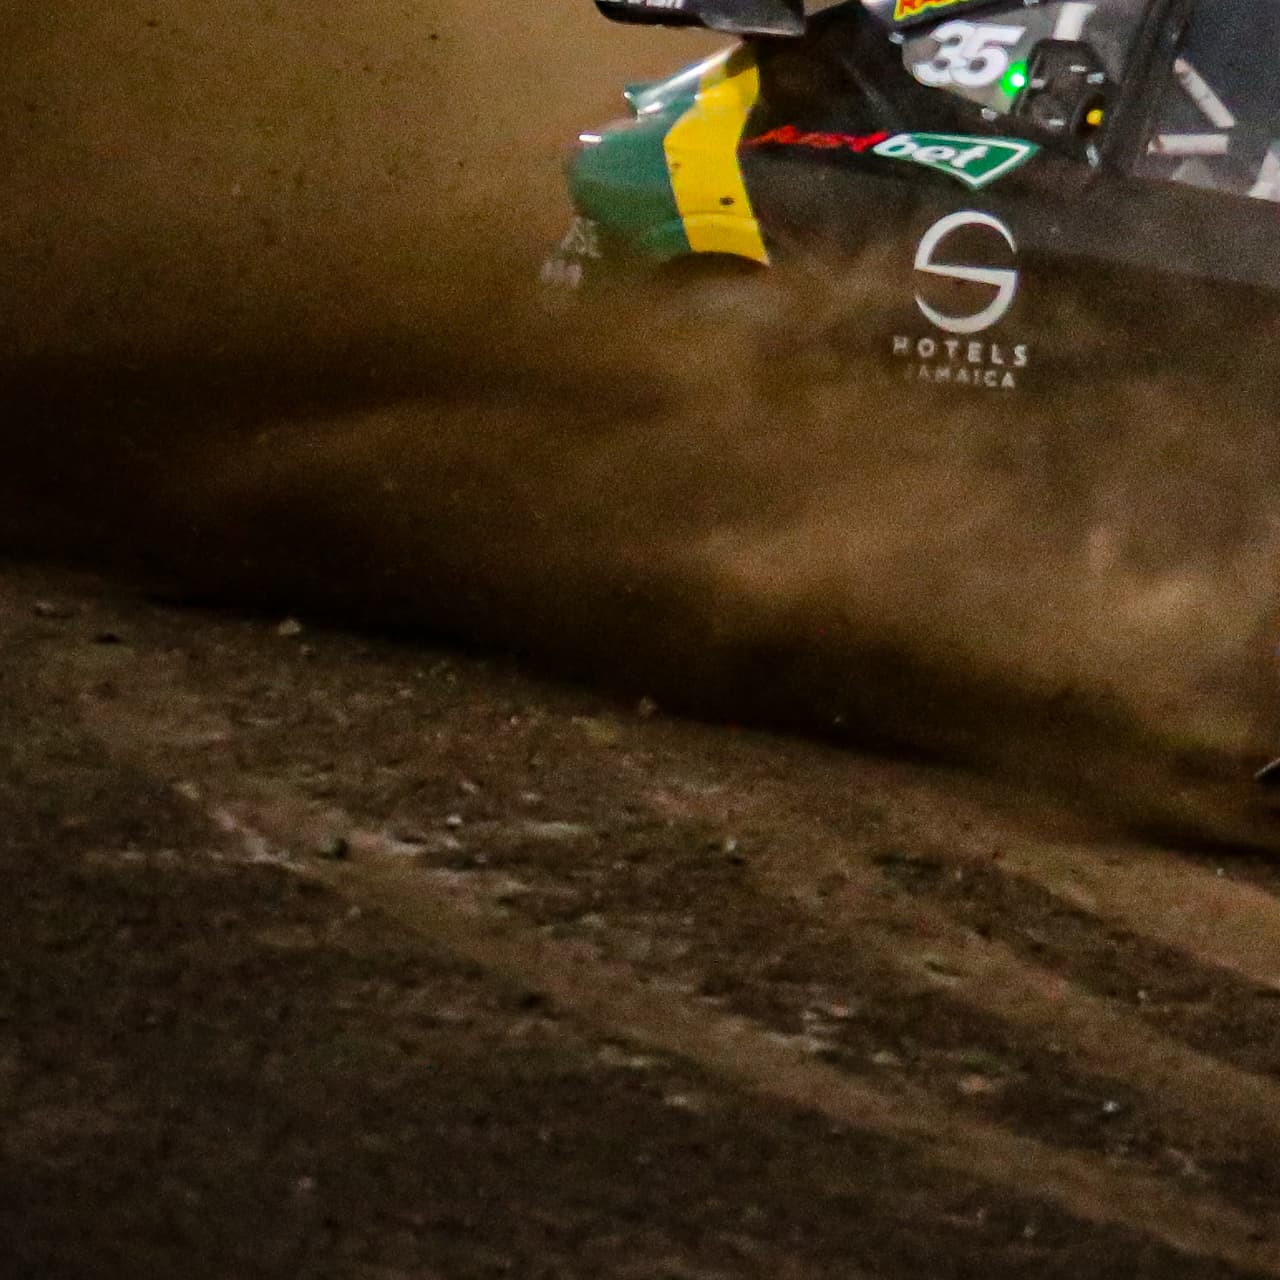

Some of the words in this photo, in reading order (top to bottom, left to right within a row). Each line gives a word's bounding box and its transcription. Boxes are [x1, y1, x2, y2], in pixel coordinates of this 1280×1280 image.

[912, 18, 1027, 87] 35
[891, 335, 1029, 367] HOTELS
[906, 364, 1016, 389] AMAICA
